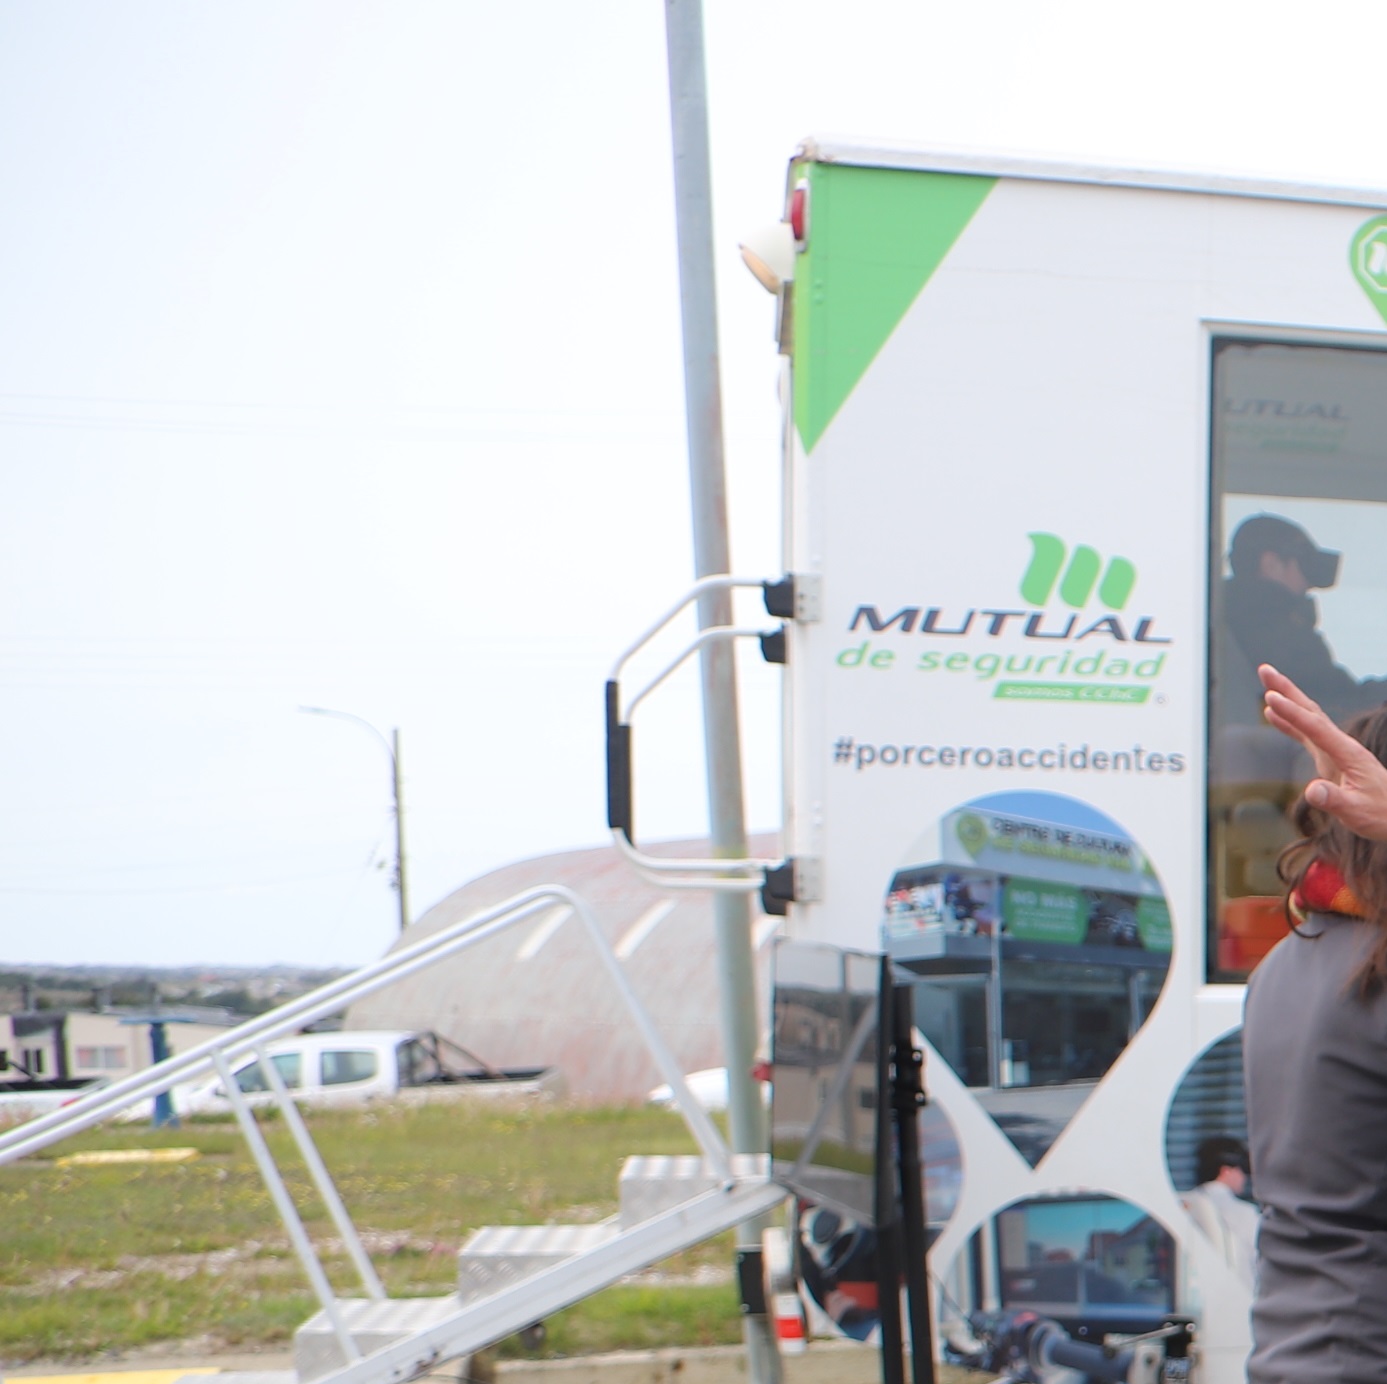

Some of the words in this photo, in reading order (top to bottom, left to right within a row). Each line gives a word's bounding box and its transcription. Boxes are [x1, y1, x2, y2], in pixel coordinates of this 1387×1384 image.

[1223, 397, 1353, 421] UTUAL
[847, 604, 1174, 645] MUTUAL
[835, 641, 897, 669] de
[917, 648, 1168, 682] seguridad
[832, 735, 1187, 773] #porceroaccidentes
